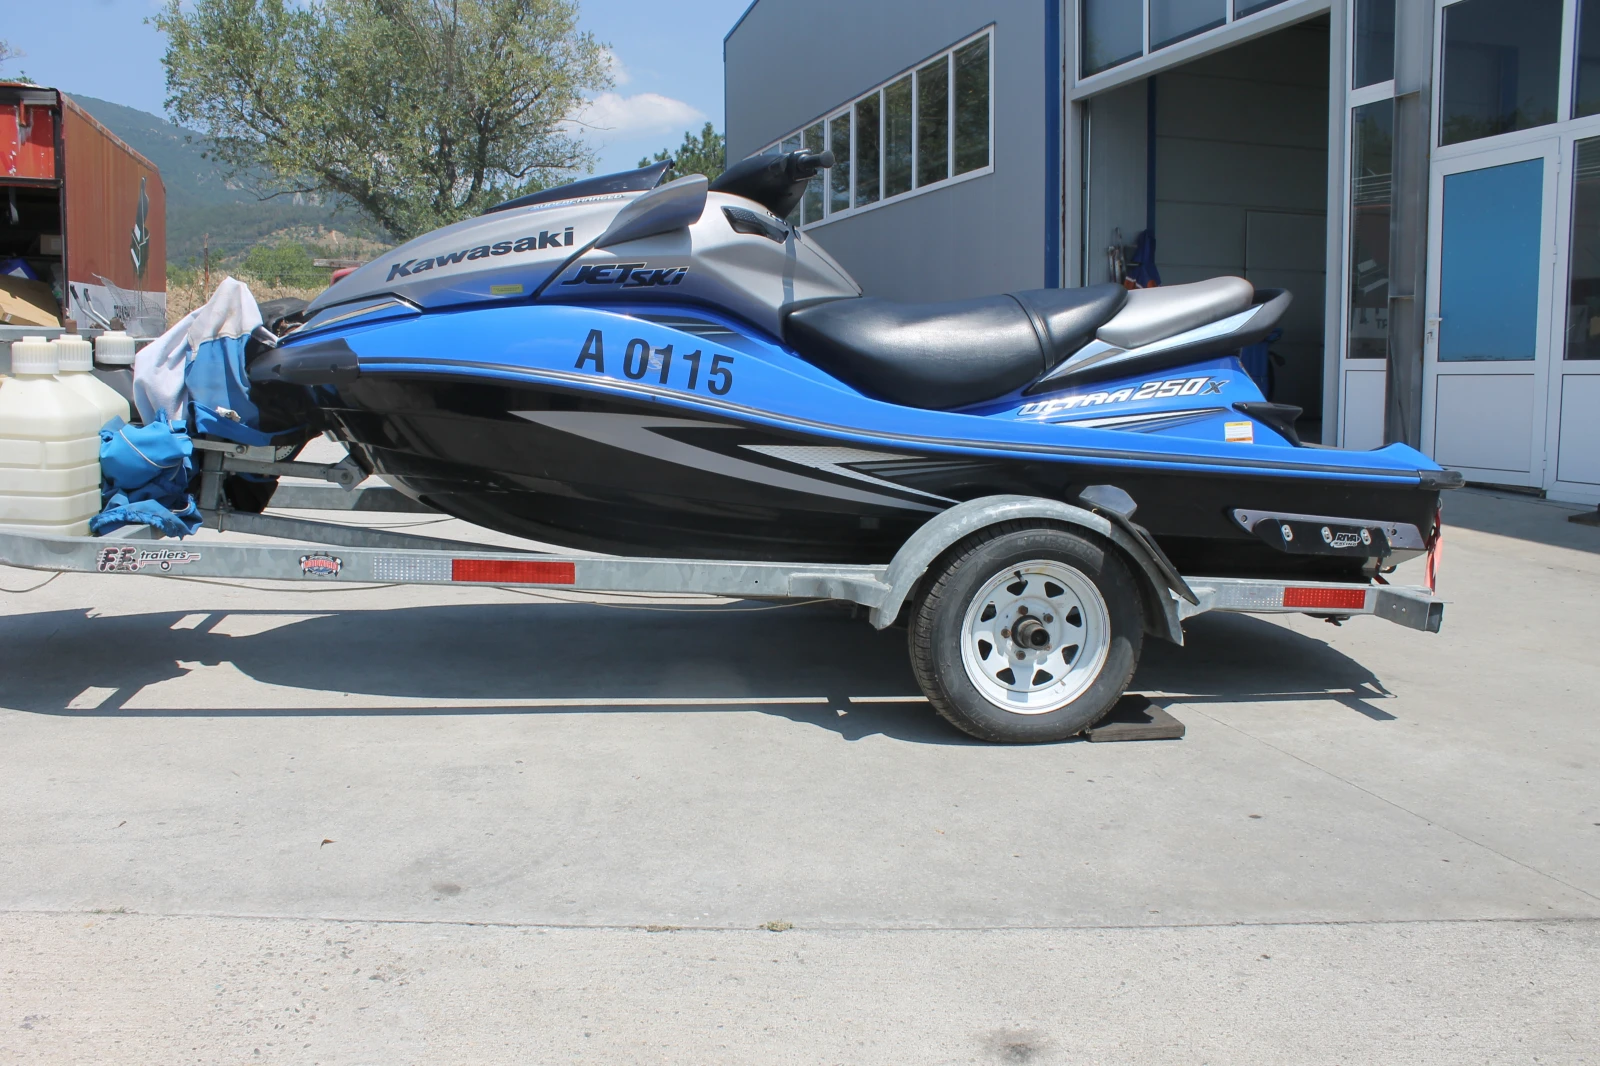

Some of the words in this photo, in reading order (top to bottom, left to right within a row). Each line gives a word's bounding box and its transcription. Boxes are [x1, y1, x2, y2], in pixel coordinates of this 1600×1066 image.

[385, 226, 574, 282] Kawasaki
[574, 329, 605, 373] A
[622, 338, 735, 396] 0115
[1017, 388, 1136, 416] ULTRA
[140, 550, 188, 560] trailers
